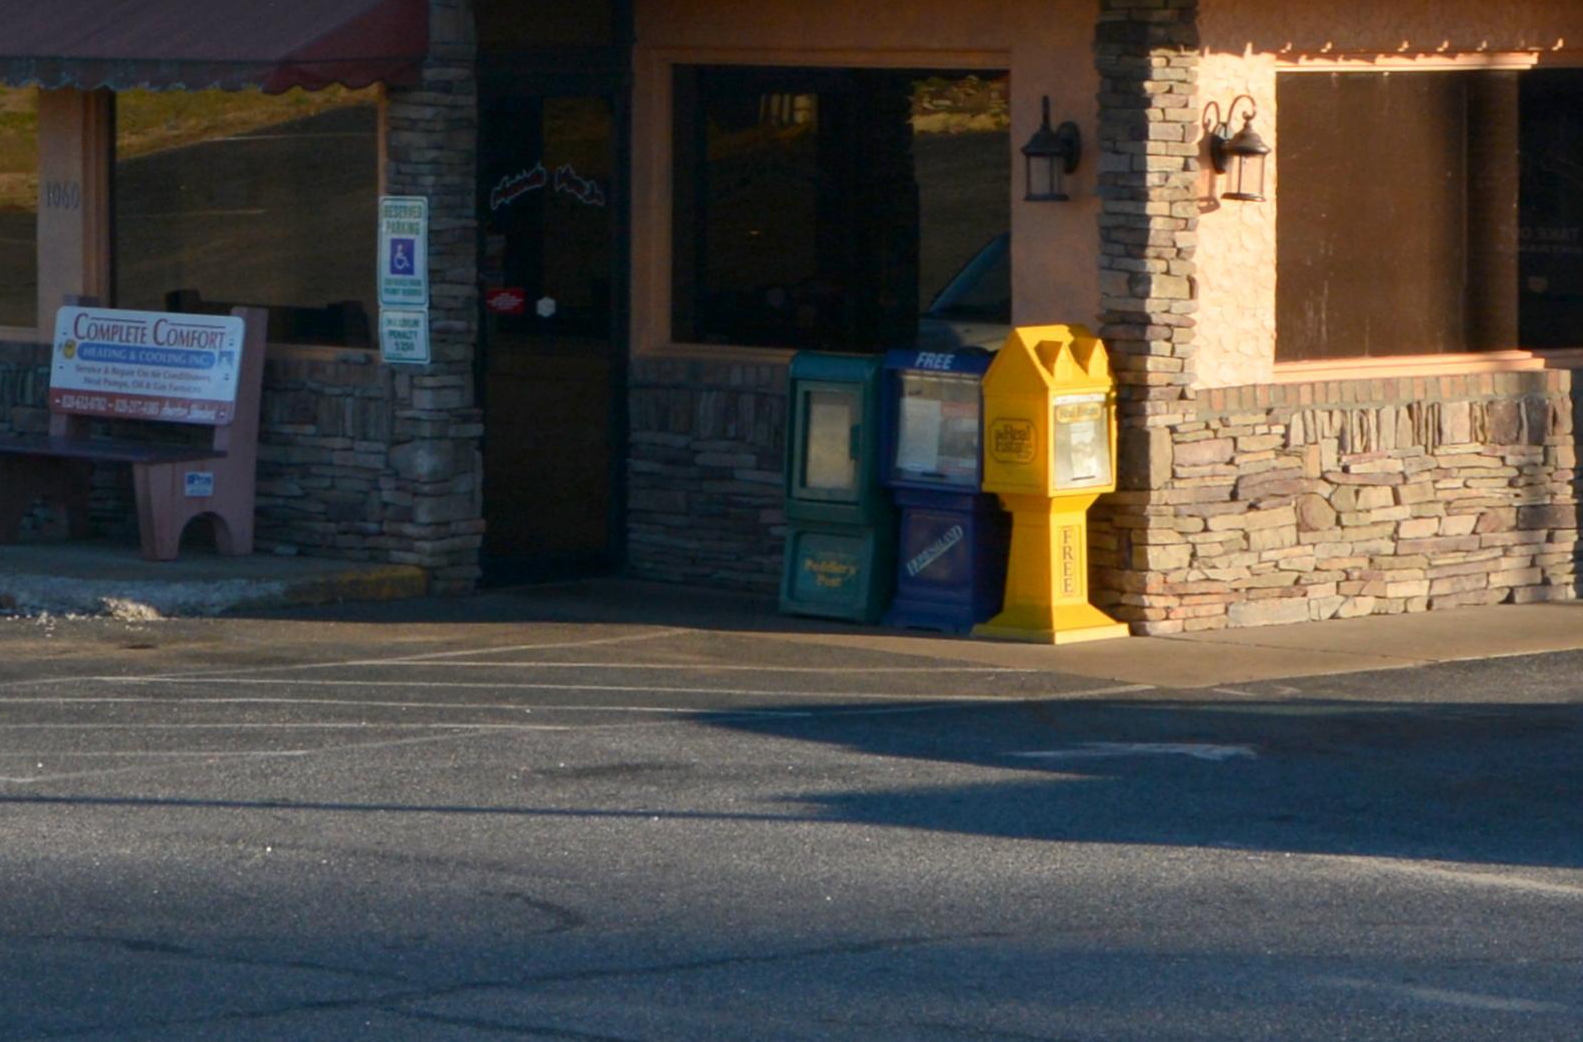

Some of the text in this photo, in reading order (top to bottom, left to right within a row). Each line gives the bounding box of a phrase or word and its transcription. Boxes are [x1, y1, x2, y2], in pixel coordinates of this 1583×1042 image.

[384, 204, 423, 219] RESERVED
[386, 221, 421, 235] PARKING
[74, 313, 226, 350] COMPLETE COMFORT
[388, 329, 418, 341] PENALTY
[83, 345, 126, 360] HEATING
[128, 350, 136, 360] &
[138, 350, 187, 364] COOLING
[915, 352, 957, 370] FREE
[75, 364, 102, 375] Service
[112, 367, 134, 379] Repair
[1003, 424, 1031, 440] Real
[1062, 529, 1074, 594] FREE
